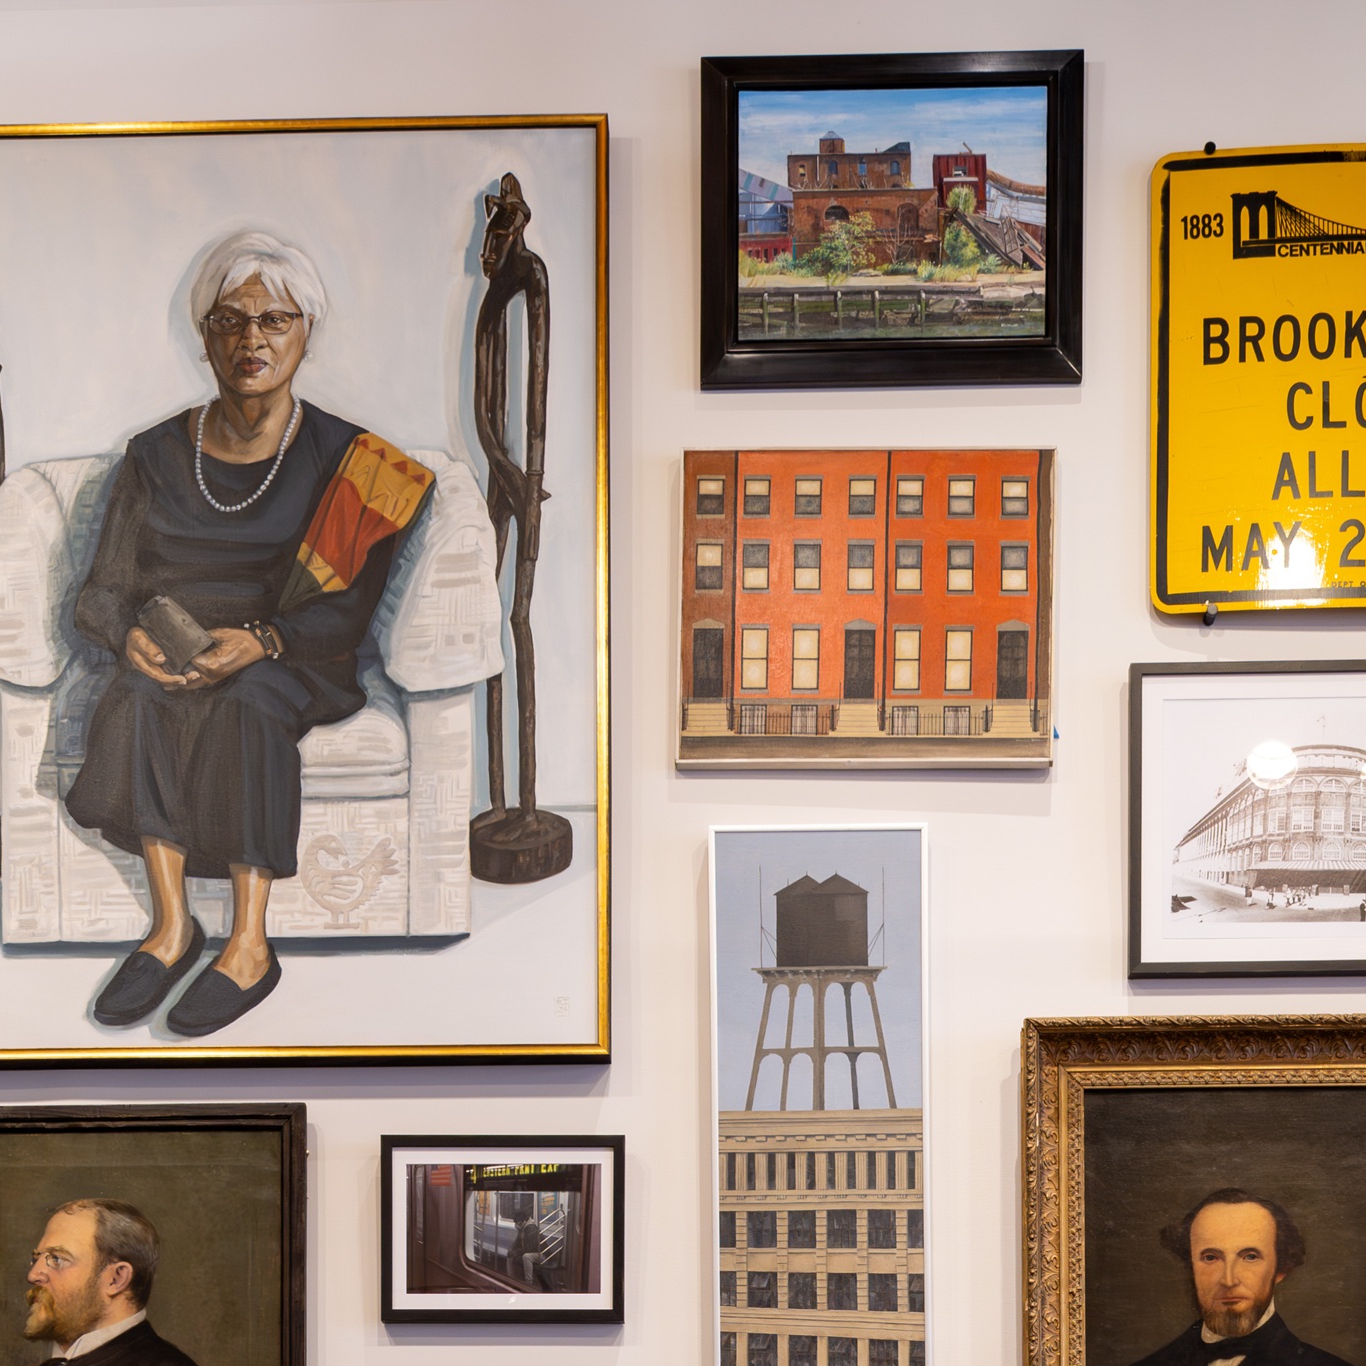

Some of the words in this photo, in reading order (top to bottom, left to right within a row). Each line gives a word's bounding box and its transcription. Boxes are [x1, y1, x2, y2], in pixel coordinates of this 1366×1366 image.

[1180, 212, 1224, 240] 1883
[1271, 449, 1366, 501] ALL
[1201, 520, 1302, 573] MAY
[1331, 580, 1353, 588] DEPT
